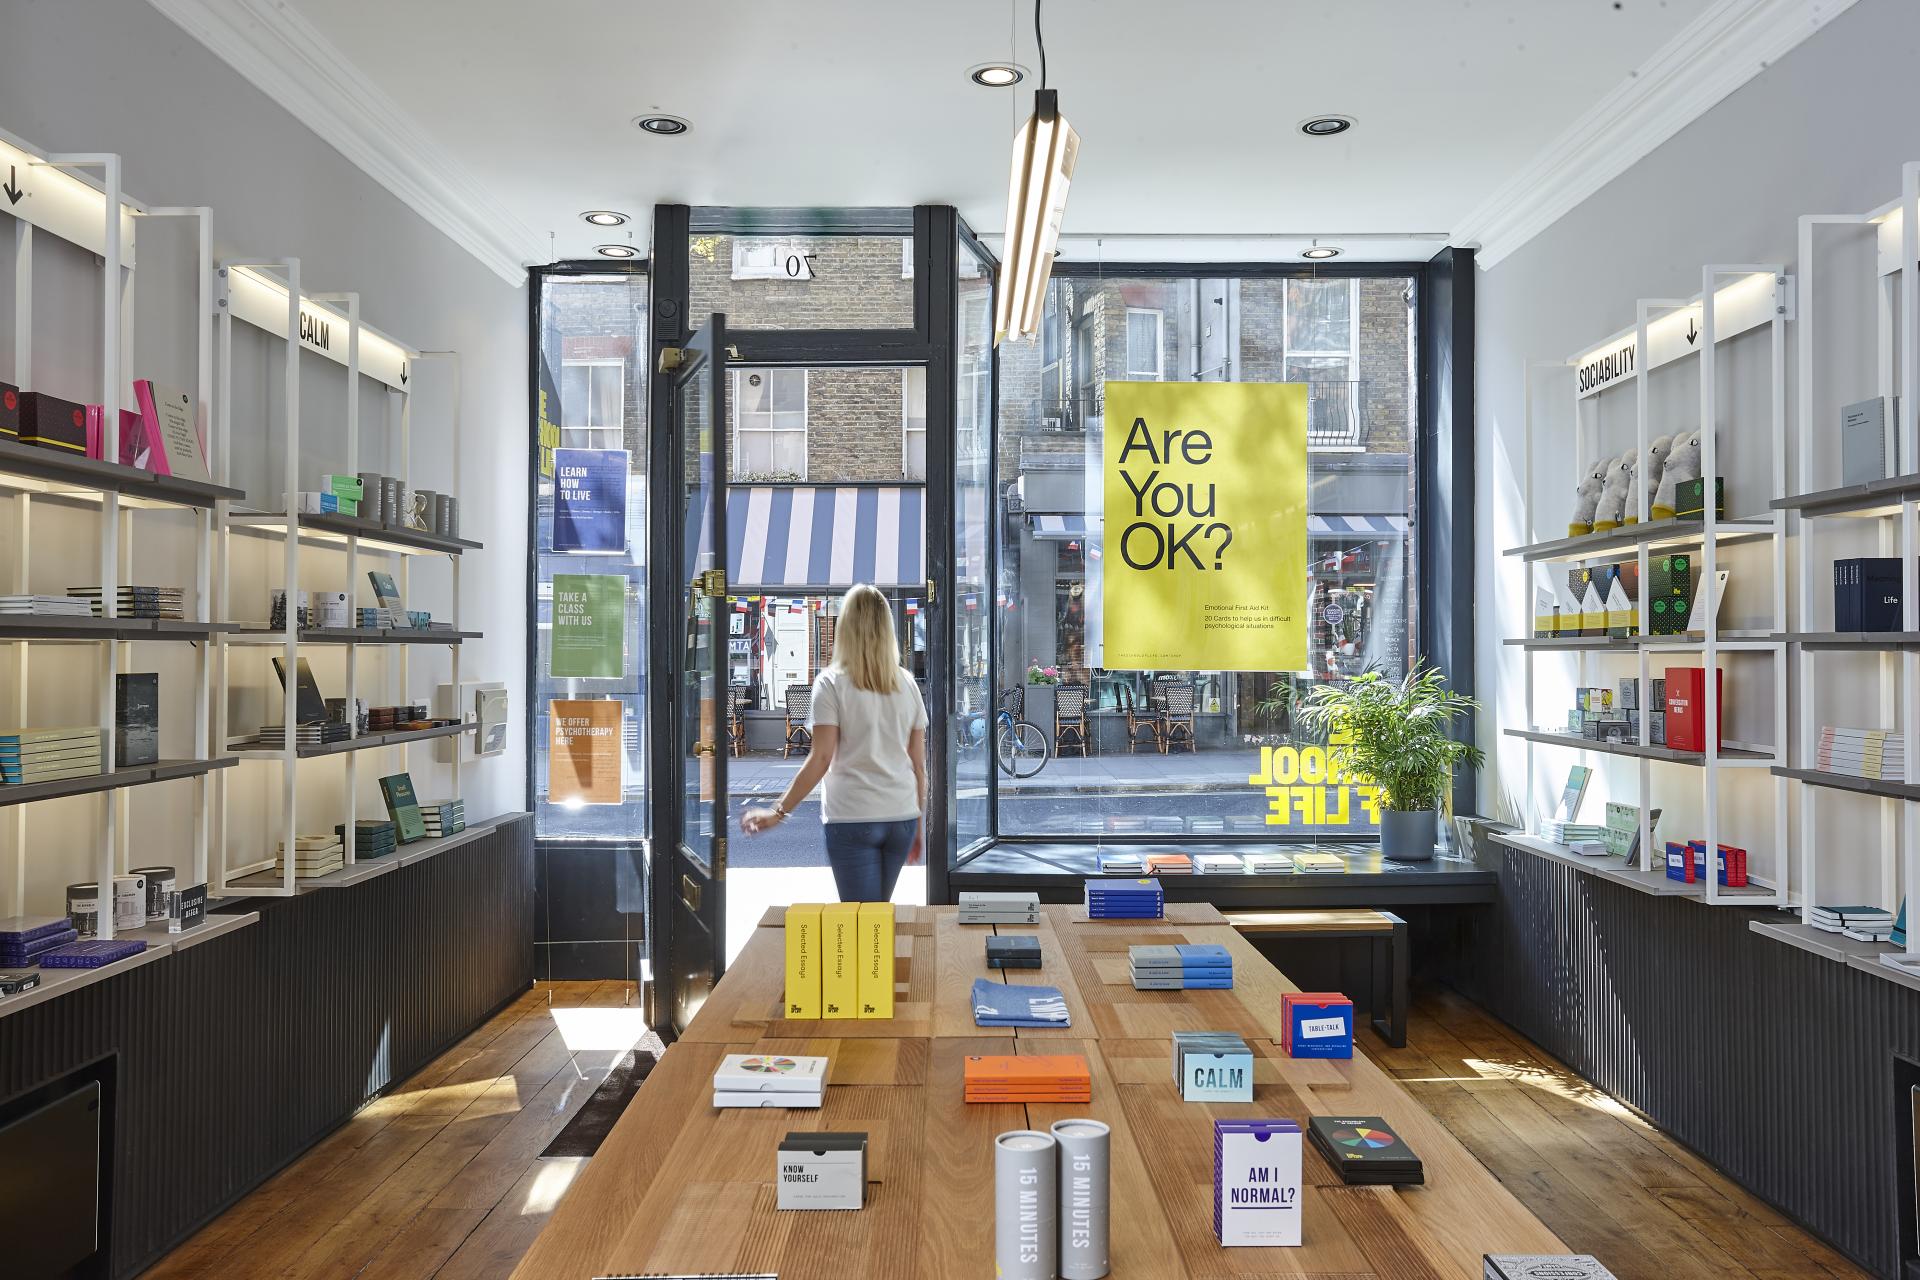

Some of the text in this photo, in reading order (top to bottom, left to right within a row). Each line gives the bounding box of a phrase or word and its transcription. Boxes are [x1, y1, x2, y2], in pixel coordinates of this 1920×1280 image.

[299, 310, 330, 351] CALM
[1579, 344, 1635, 392] SOCIABILITY
[1118, 417, 1213, 464] Are
[560, 467, 587, 478] LEARN
[560, 479, 579, 488] HOW
[560, 490, 591, 500] TO LIVE
[1119, 470, 1216, 518] You
[1119, 523, 1233, 571] OK?
[558, 592, 587, 602] TAKE A
[1884, 596, 1898, 604] Life
[558, 604, 584, 614] CLASS
[558, 616, 592, 625] WITH US
[556, 718, 590, 726] WE OFFER
[556, 727, 613, 736] PSYCHOTHERAPY
[556, 737, 573, 745] HERE
[799, 956, 807, 978] Essays
[836, 954, 844, 978] Essays
[872, 955, 880, 978] Essays
[1194, 1068, 1243, 1088] CALM
[784, 1165, 804, 1174] KNOW
[1073, 1154, 1090, 1171] 15
[784, 1174, 819, 1182] YOURSELF
[1249, 1167, 1278, 1182] AM I
[1231, 1188, 1295, 1203] NORMAL?
[1019, 1168, 1038, 1263] 15 MINUTES
[1072, 1177, 1090, 1248] MINUTES
